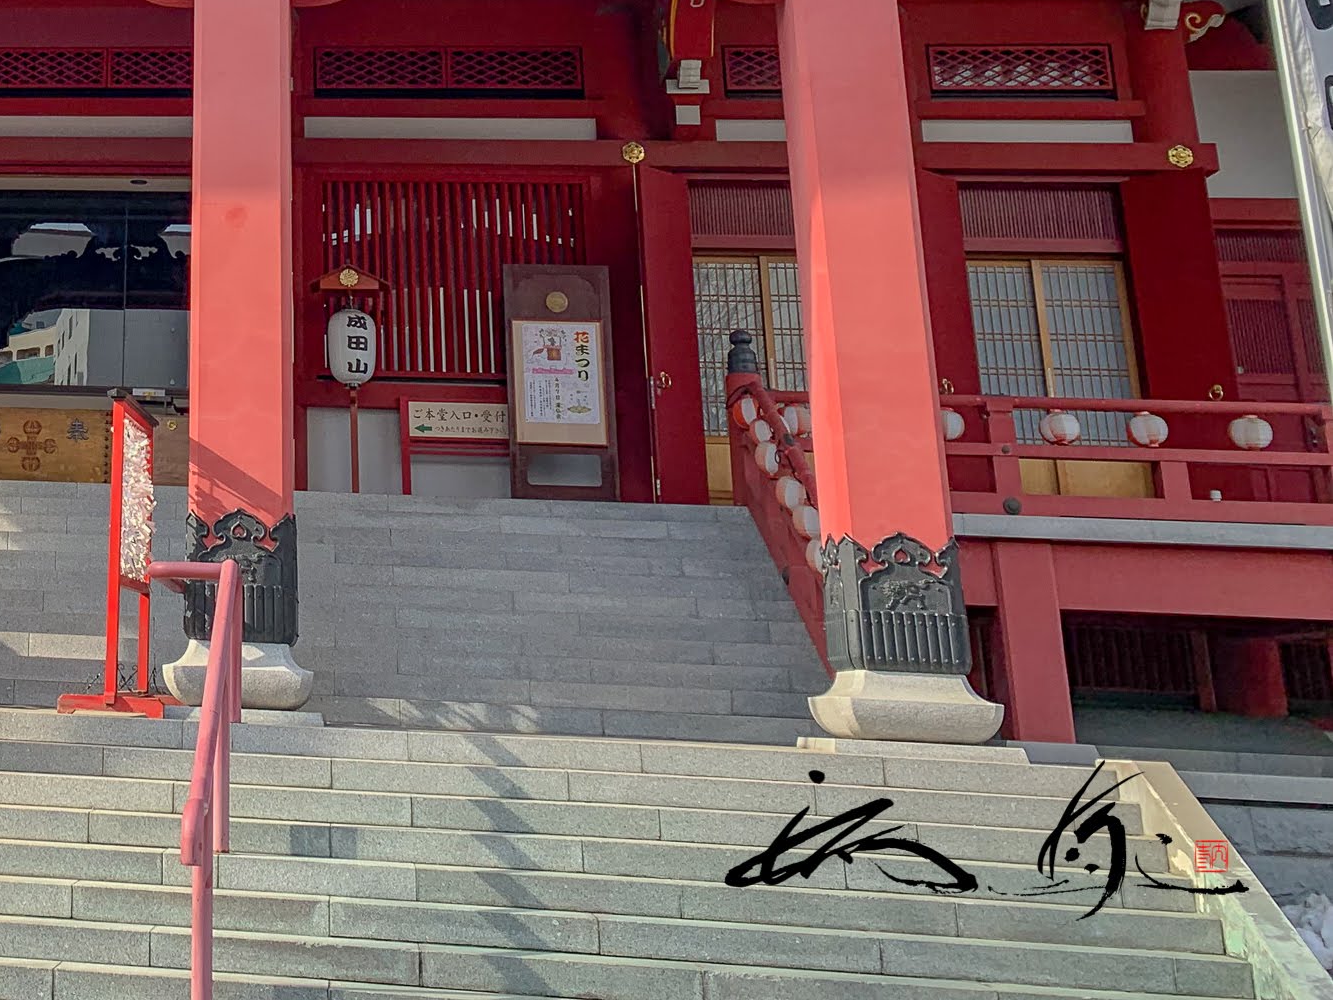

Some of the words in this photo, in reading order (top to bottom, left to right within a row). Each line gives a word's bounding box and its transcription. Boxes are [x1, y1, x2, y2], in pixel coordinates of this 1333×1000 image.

[347, 314, 368, 375] 成田山
[574, 331, 590, 382] 花まつり
[413, 407, 506, 423] ご本堂入口・受付
